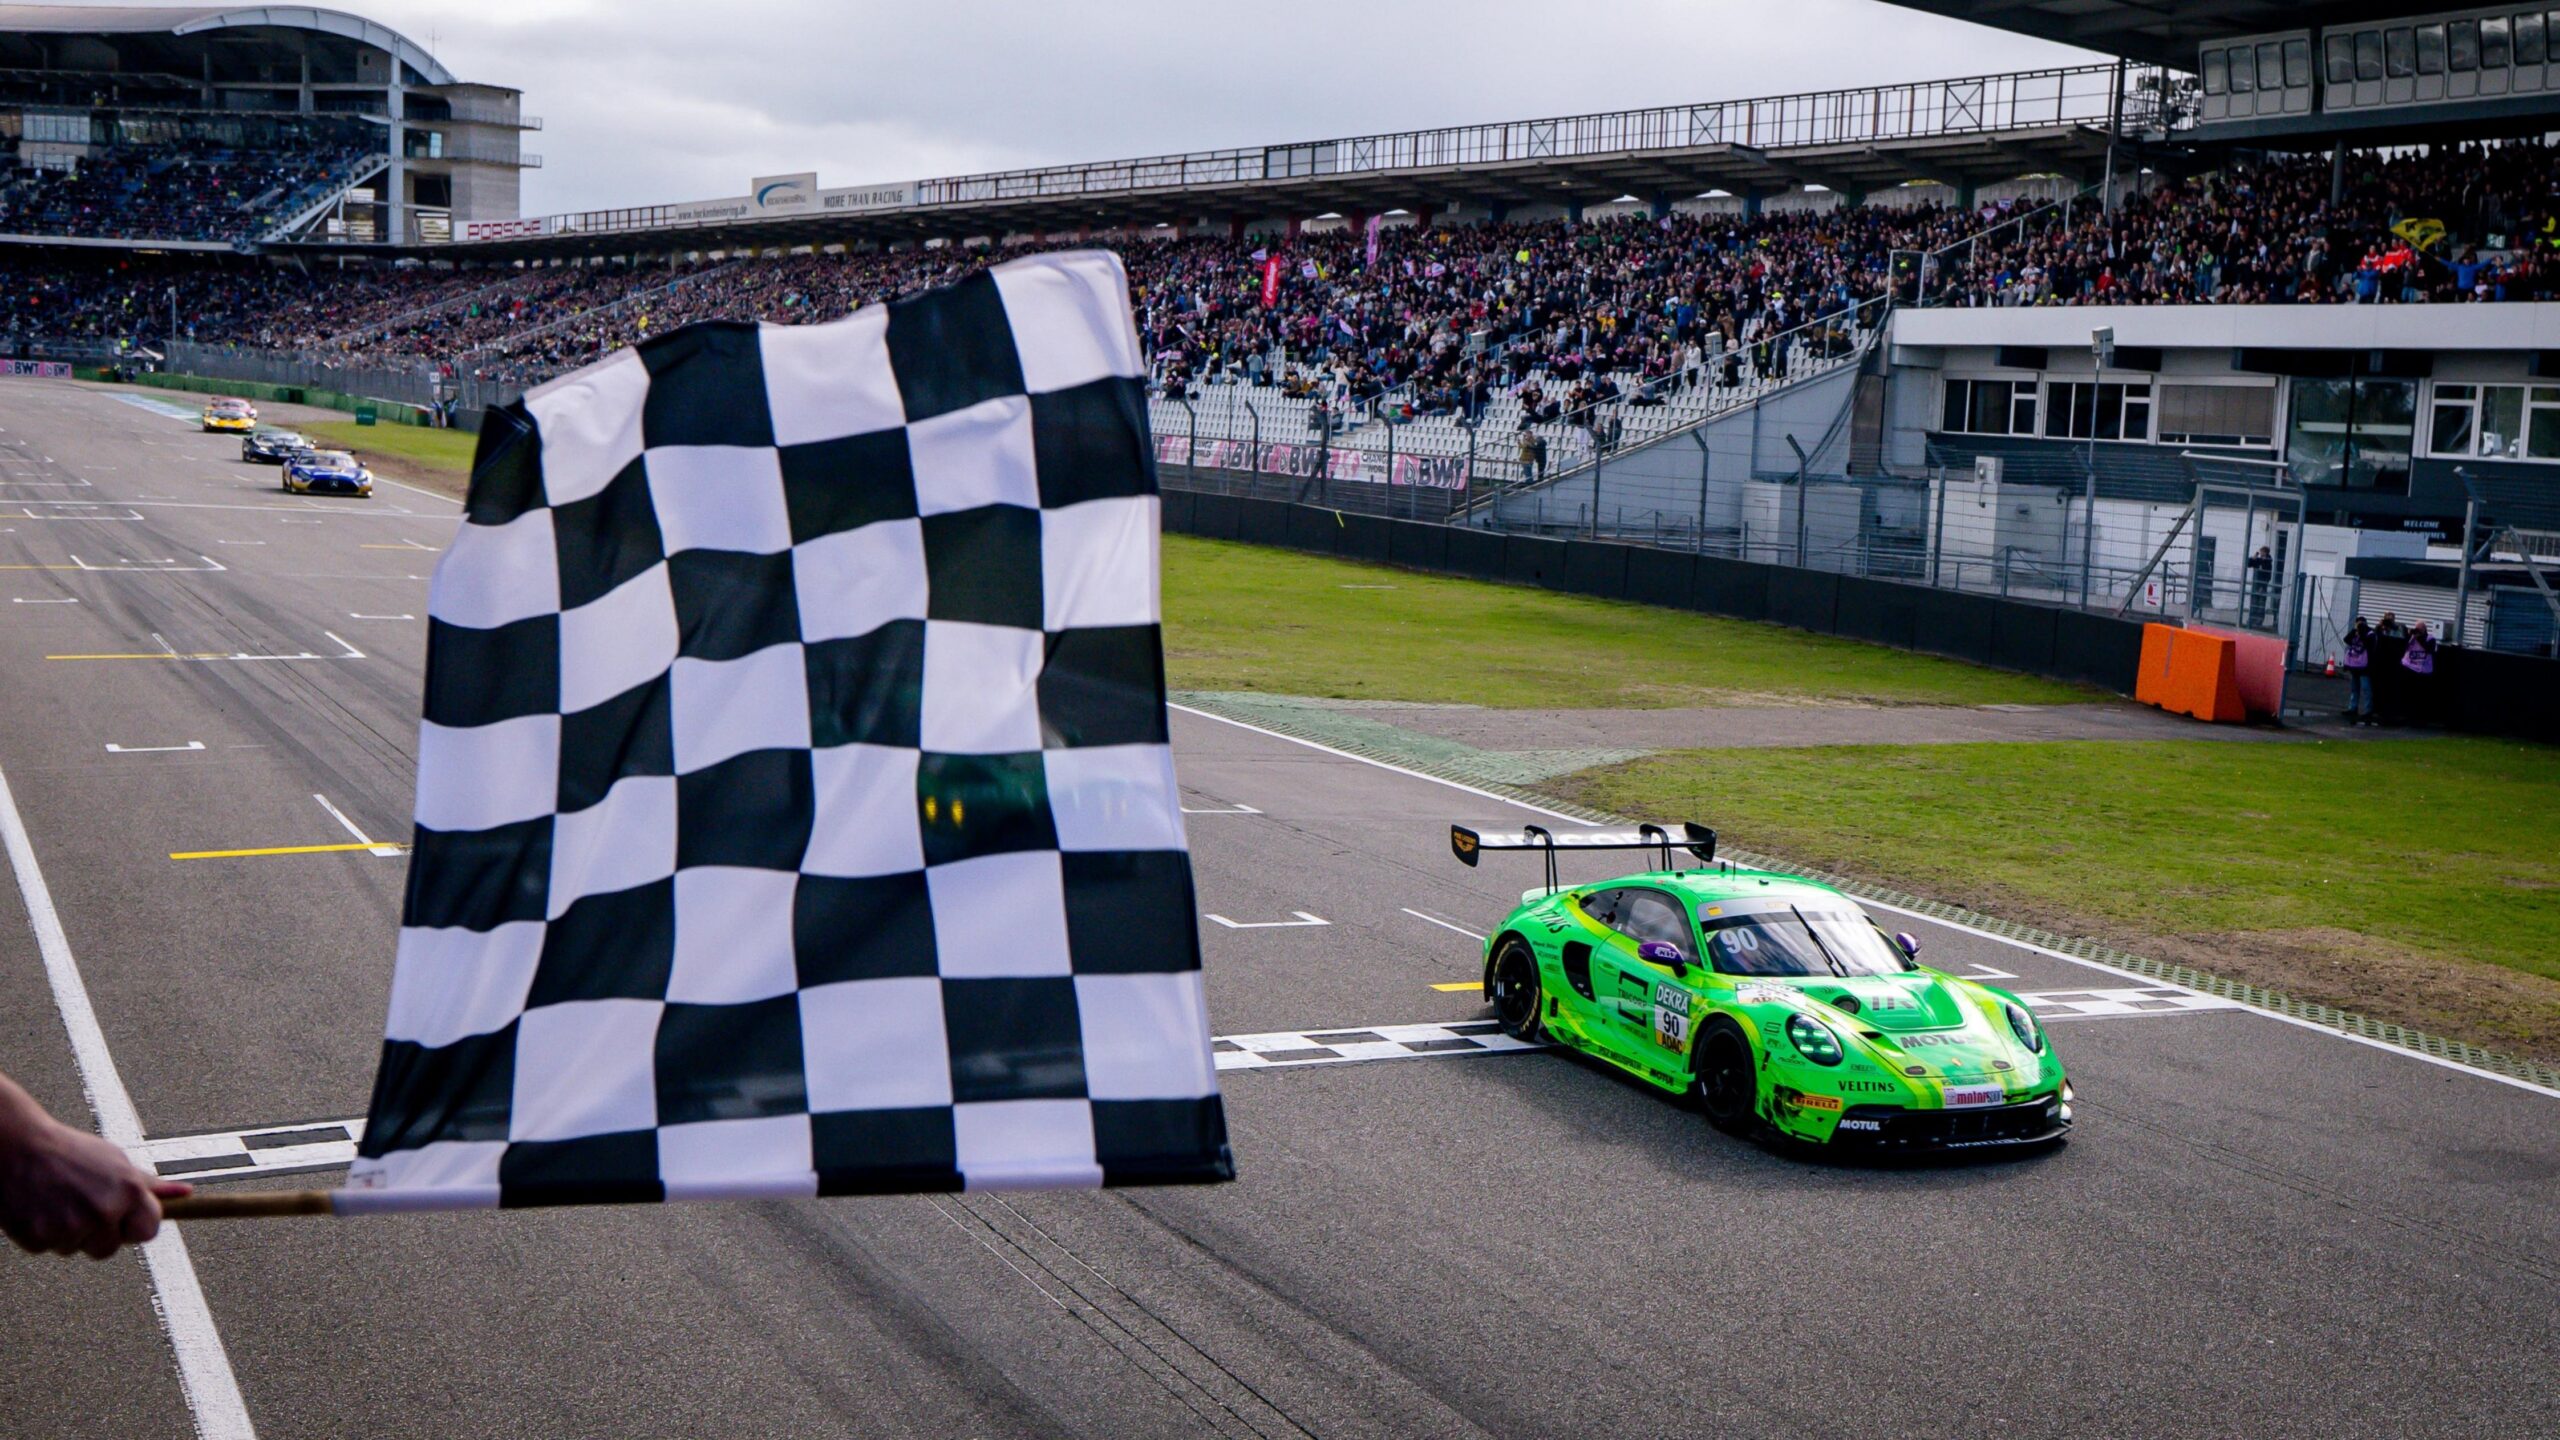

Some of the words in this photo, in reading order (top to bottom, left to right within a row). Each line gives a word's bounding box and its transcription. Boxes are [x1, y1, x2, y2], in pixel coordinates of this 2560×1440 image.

[824, 195, 845, 208] MORE
[848, 192, 870, 206] THAN
[872, 189, 903, 204] RACING
[467, 219, 541, 241] PORSCHE
[15, 361, 38, 375] BWT
[1230, 442, 1274, 471] BWT
[1362, 452, 1388, 464] CHANG
[1367, 464, 1387, 474] WORL
[1418, 457, 1465, 489] BWT
[2403, 519, 2440, 529] WELCOME
[1720, 927, 1758, 954] 90
[1656, 985, 1689, 1013] DEKRA
[1663, 1011, 1680, 1037] 90
[1838, 1080, 1896, 1093] VELTINS
[1795, 1096, 1839, 1110] PIRELLI
[1839, 1119, 1880, 1131] MOTUL
